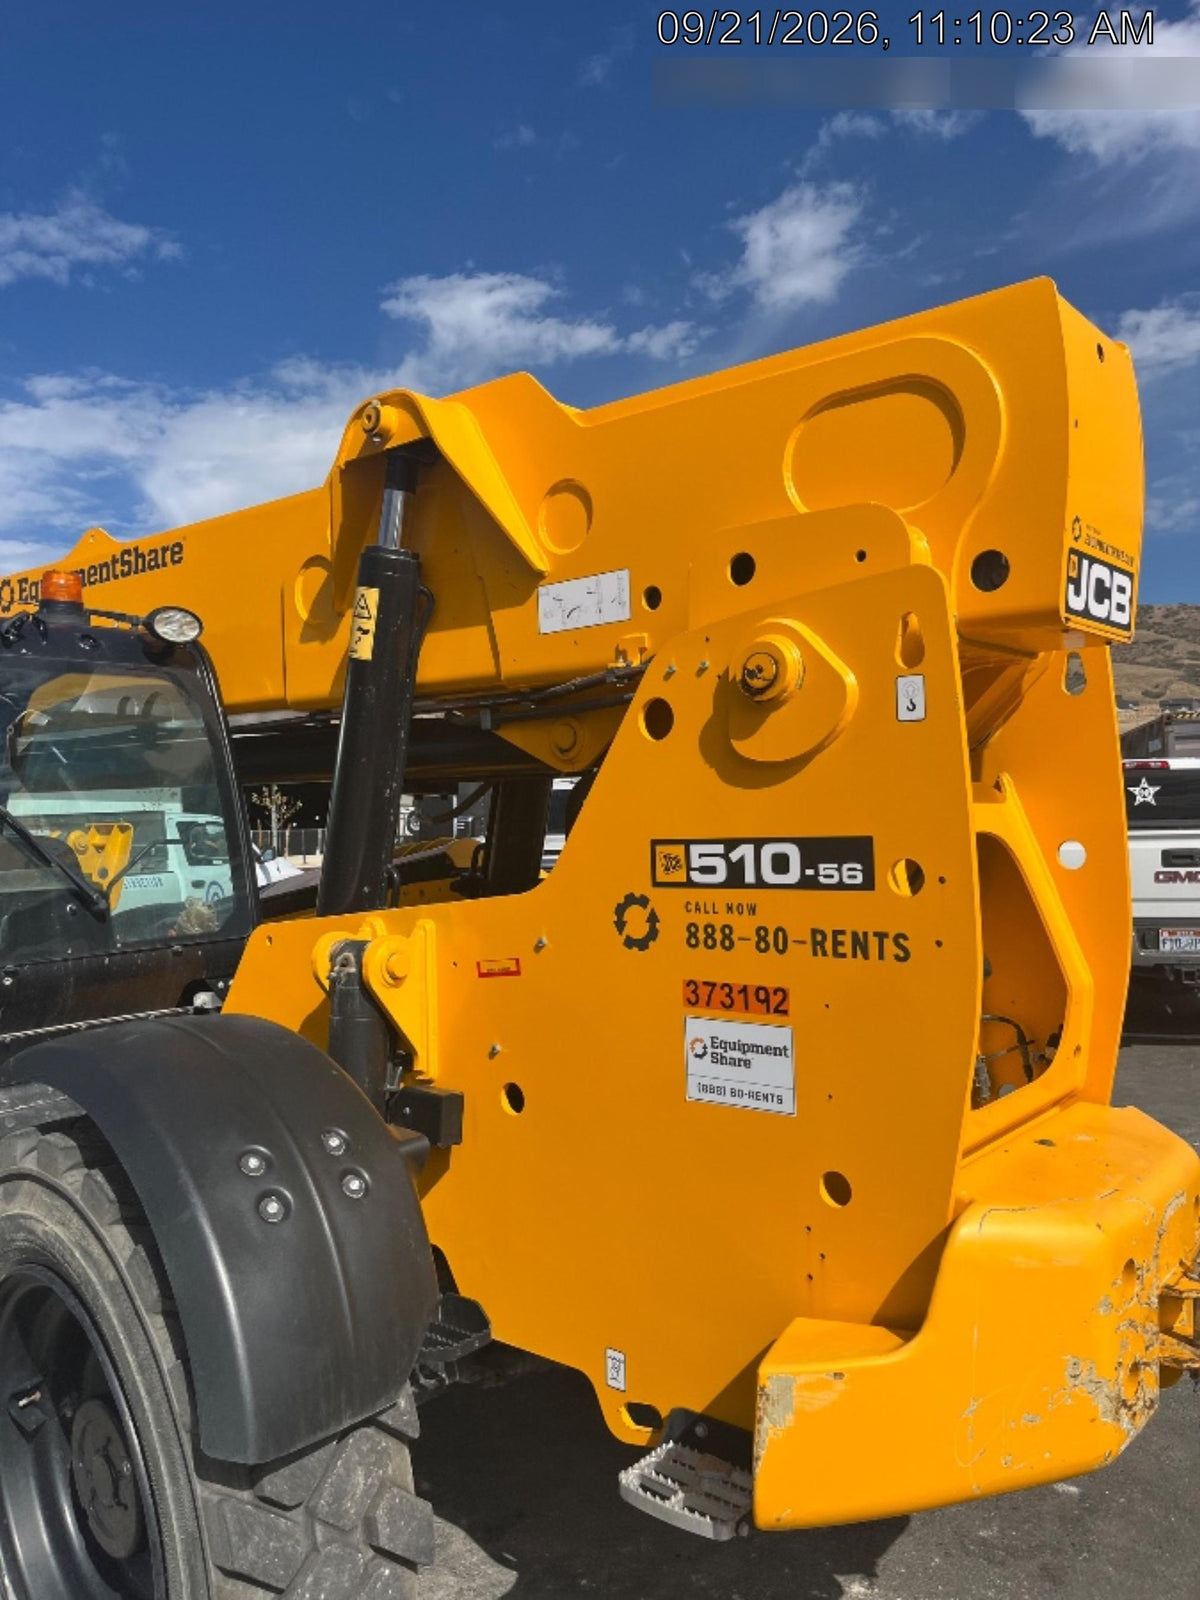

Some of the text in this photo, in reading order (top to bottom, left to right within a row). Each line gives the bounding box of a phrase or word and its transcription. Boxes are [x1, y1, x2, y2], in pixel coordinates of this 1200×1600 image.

[1068, 558, 1131, 625] JCB
[689, 842, 863, 884] 510-56
[685, 901, 757, 916] CALL NOW
[686, 922, 911, 962] 888-80-RENTS
[686, 980, 788, 1015] 373192
[710, 1036, 789, 1058] Equipment
[710, 1051, 751, 1069] Share
[730, 1088, 783, 1105] 80-RENTS
